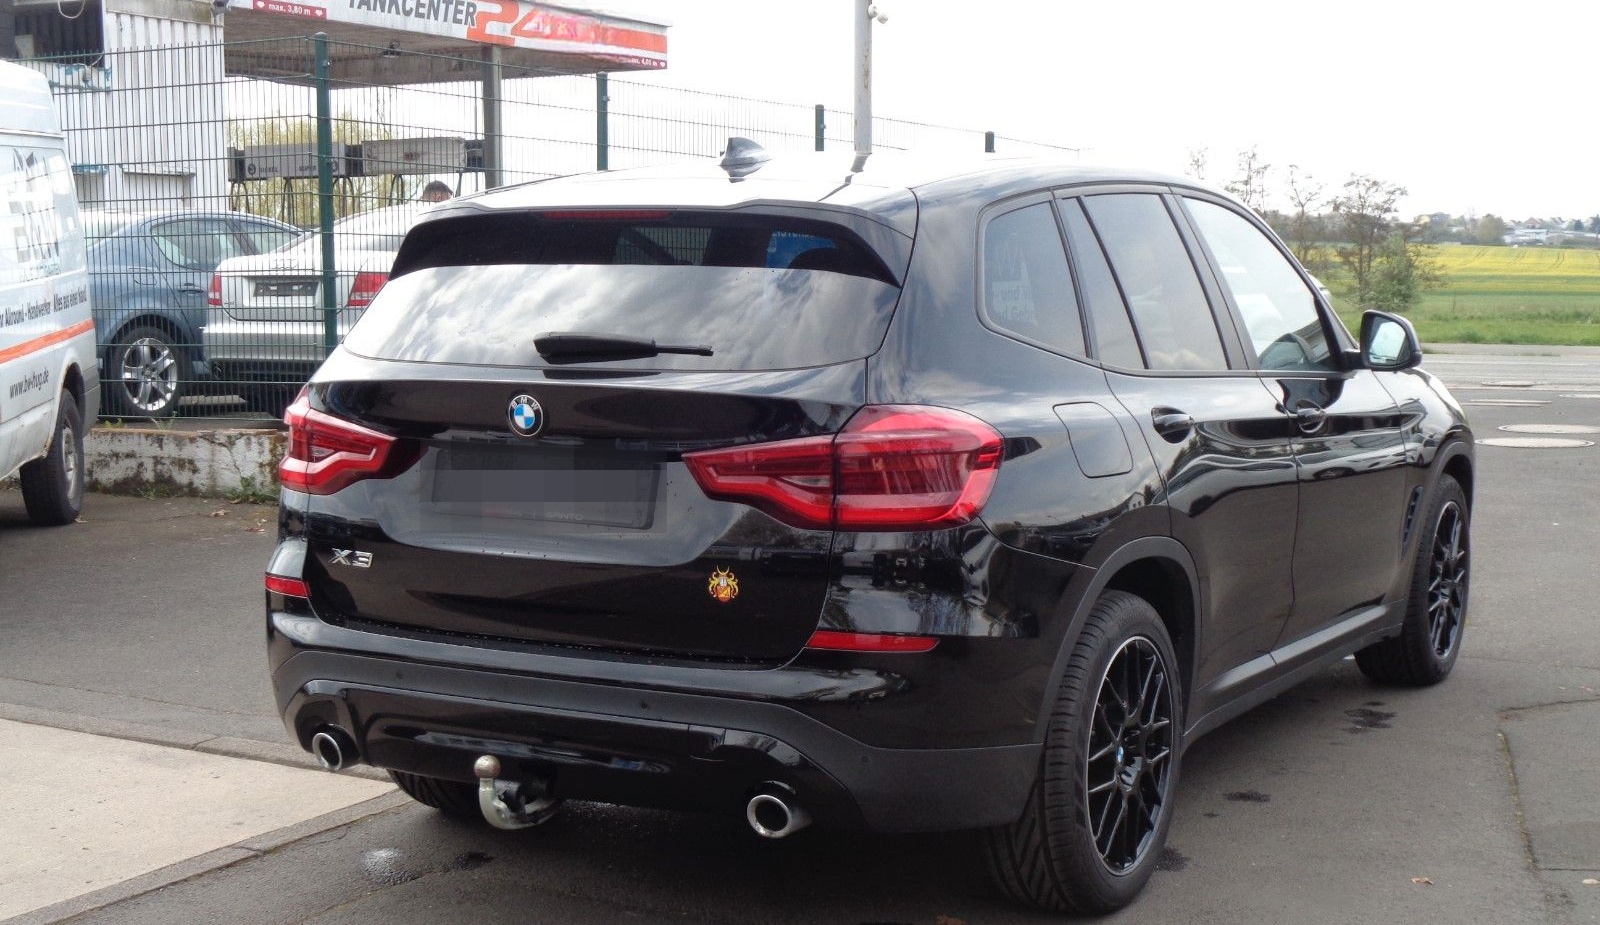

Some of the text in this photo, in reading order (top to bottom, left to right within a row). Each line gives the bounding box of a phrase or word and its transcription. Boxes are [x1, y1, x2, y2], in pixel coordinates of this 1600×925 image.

[269, 4, 285, 12] max.
[511, 396, 539, 411] BMW
[329, 547, 373, 568] X3
